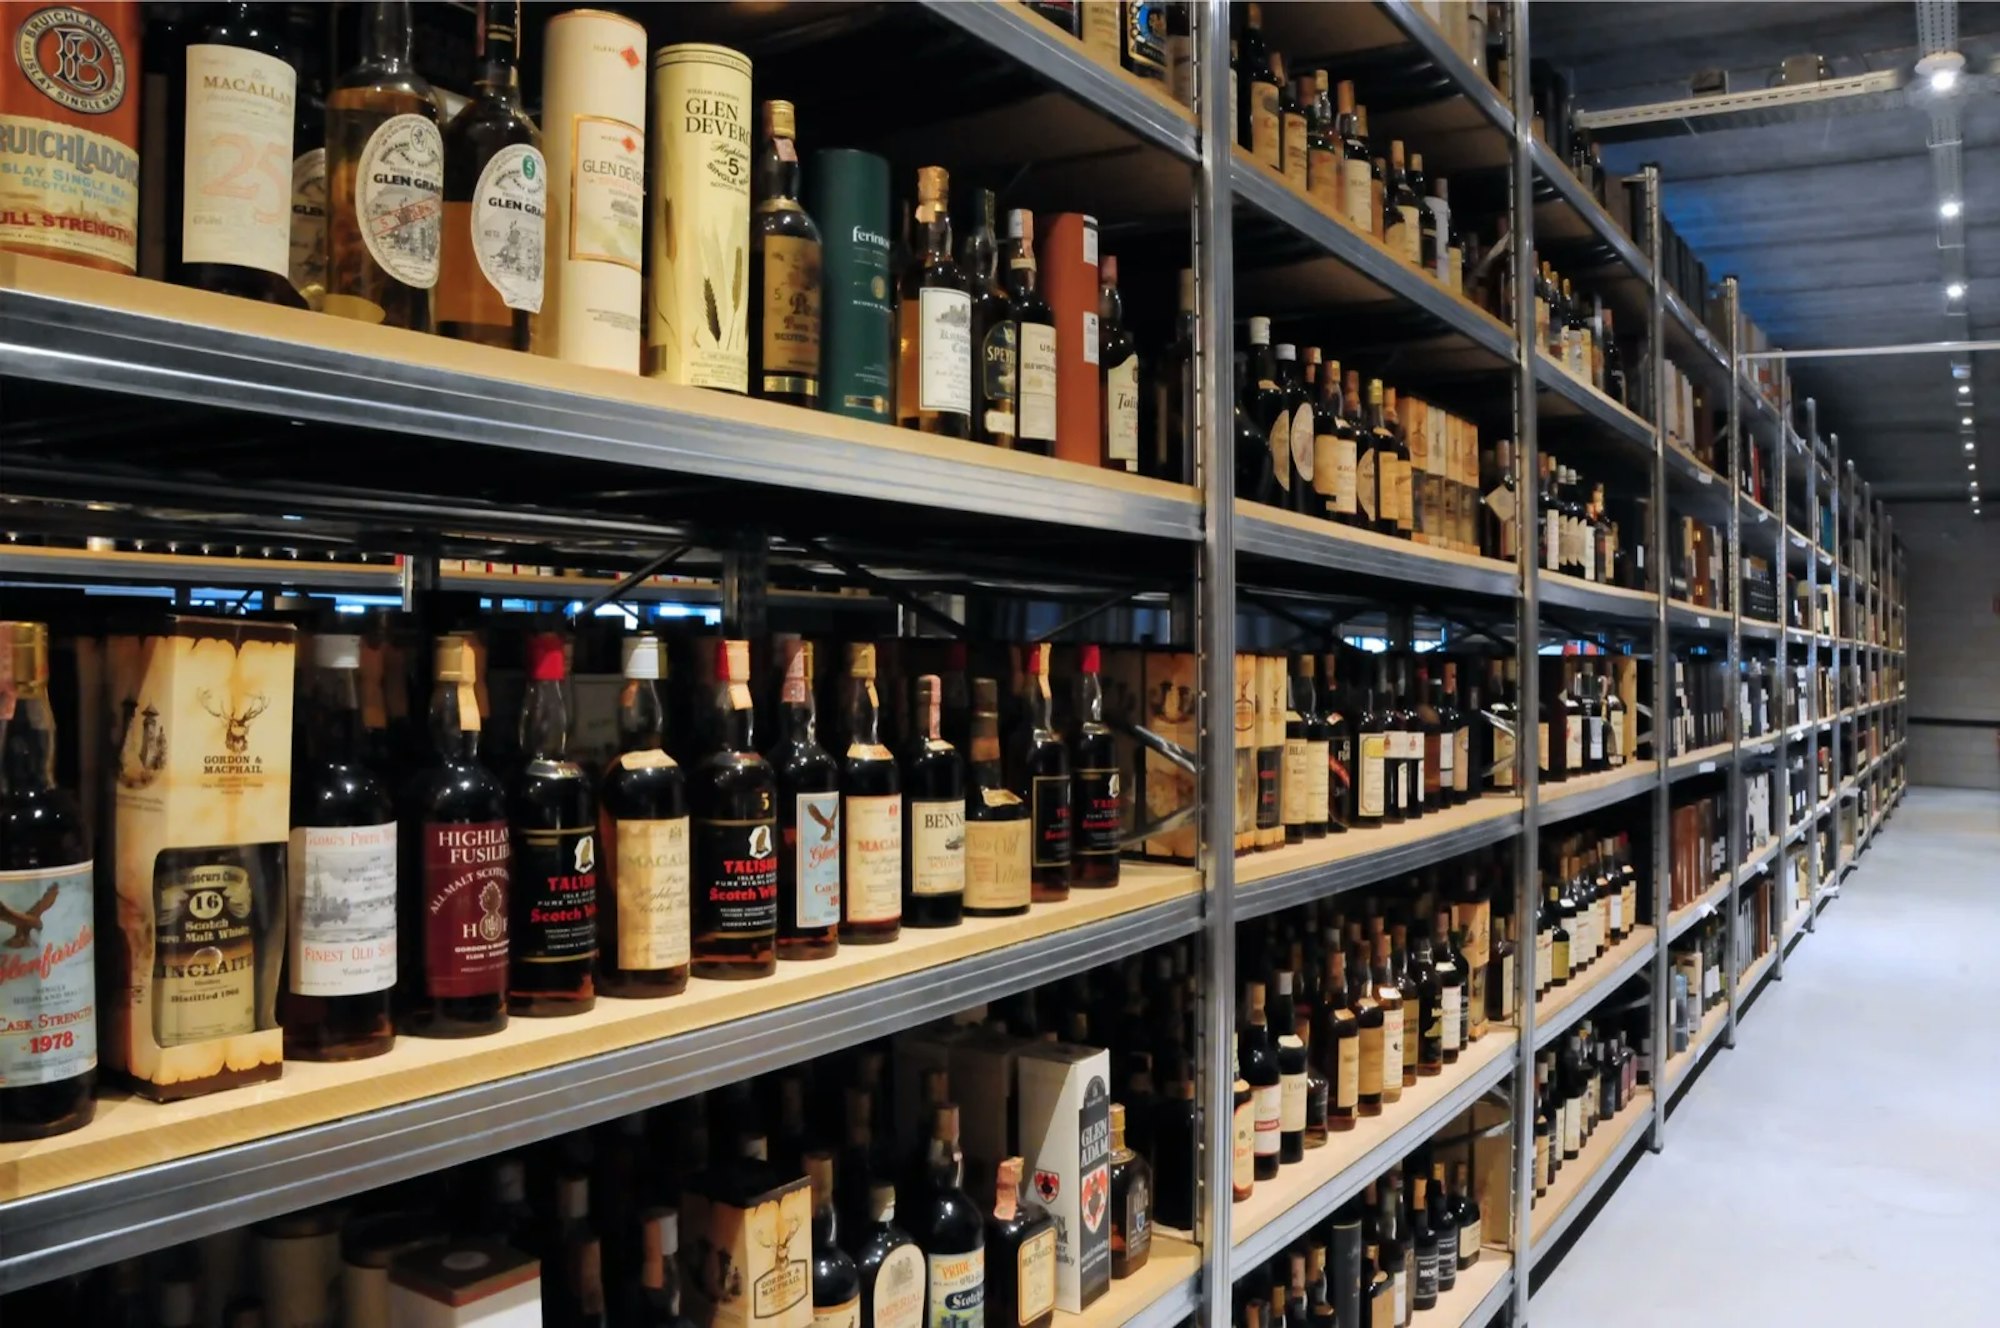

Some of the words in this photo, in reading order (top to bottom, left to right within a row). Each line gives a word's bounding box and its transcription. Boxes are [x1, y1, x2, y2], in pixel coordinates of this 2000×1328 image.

[25, 12, 121, 65] BRUICHLADDICH
[56, 91, 101, 109] SINGLE
[686, 98, 738, 121] GLEN
[583, 160, 617, 176] GLEN
[707, 162, 736, 185] SINGLE
[728, 157, 739, 176] 5
[202, 132, 289, 225] 25
[373, 173, 411, 187] GLEN
[489, 197, 522, 211] GLEN
[42, 213, 136, 247] STRENGTH
[204, 755, 250, 764] GORDON
[204, 765, 263, 774] MACPHAIL
[761, 792, 770, 810] 5
[196, 894, 219, 911] 16
[430, 893, 447, 915] ALL
[443, 872, 474, 896] MALT
[710, 886, 757, 901] Scotch
[531, 907, 582, 923] Scotch
[185, 918, 229, 931] Scotch
[463, 922, 477, 939] H
[185, 930, 214, 943] Malt
[304, 945, 345, 962] FINEST
[351, 944, 374, 961] OLD
[171, 993, 218, 1003] Distilled
[30, 1030, 74, 1054] 1978
[1081, 1116, 1108, 1148] GLEN
[1081, 1135, 1109, 1168] ADAM
